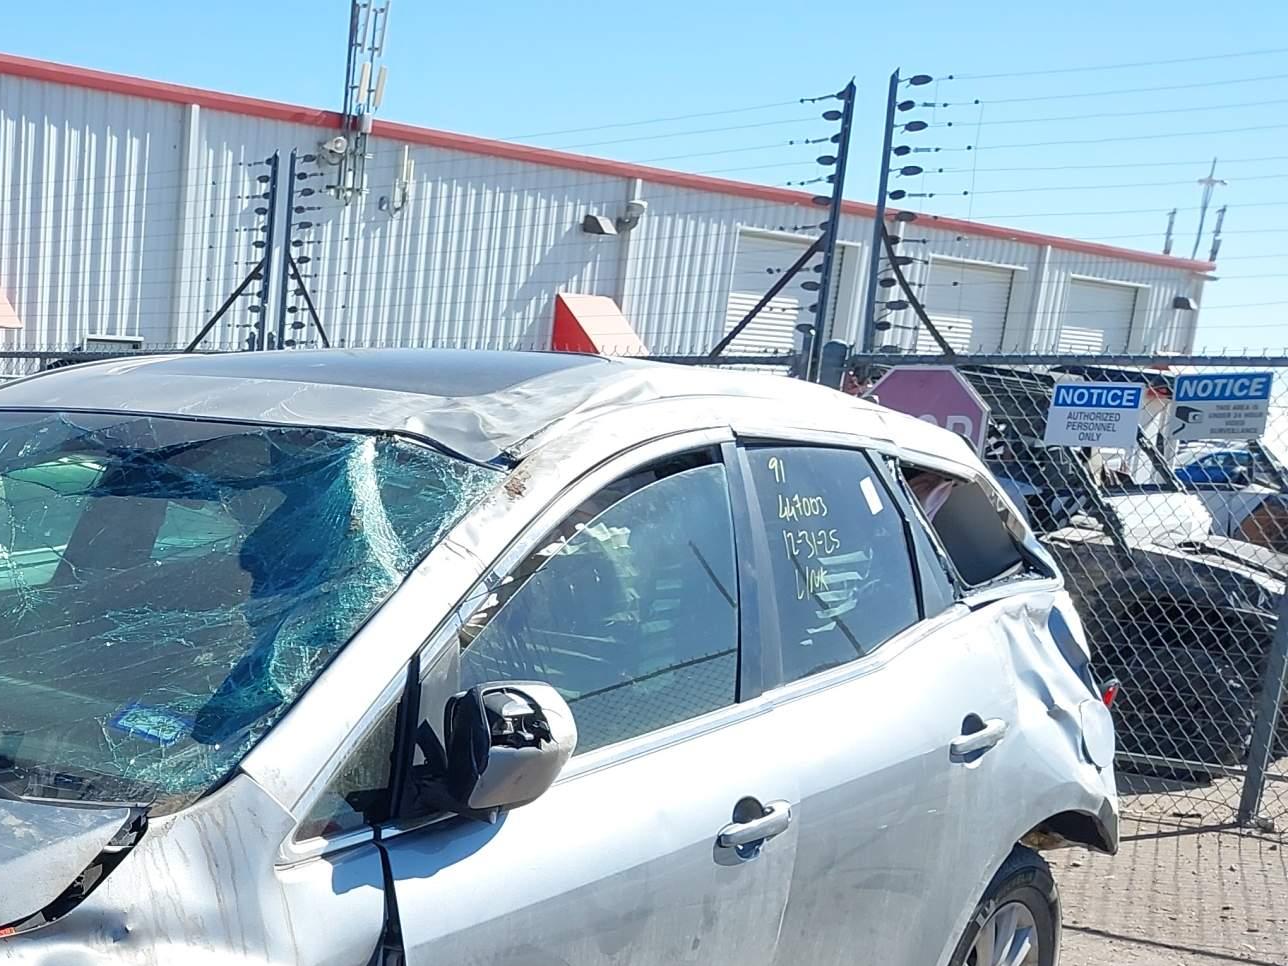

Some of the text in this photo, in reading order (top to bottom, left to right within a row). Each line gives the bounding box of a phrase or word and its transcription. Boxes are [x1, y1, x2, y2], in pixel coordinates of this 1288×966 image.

[1178, 377, 1267, 398] NOTICE
[1058, 388, 1137, 407] NOTICE
[1067, 411, 1121, 423] AUTHORIZED
[1065, 421, 1117, 433] PERSONNEL
[1078, 432, 1102, 442] ONLY
[768, 457, 786, 483] 91
[782, 529, 840, 560] 12-31-25
